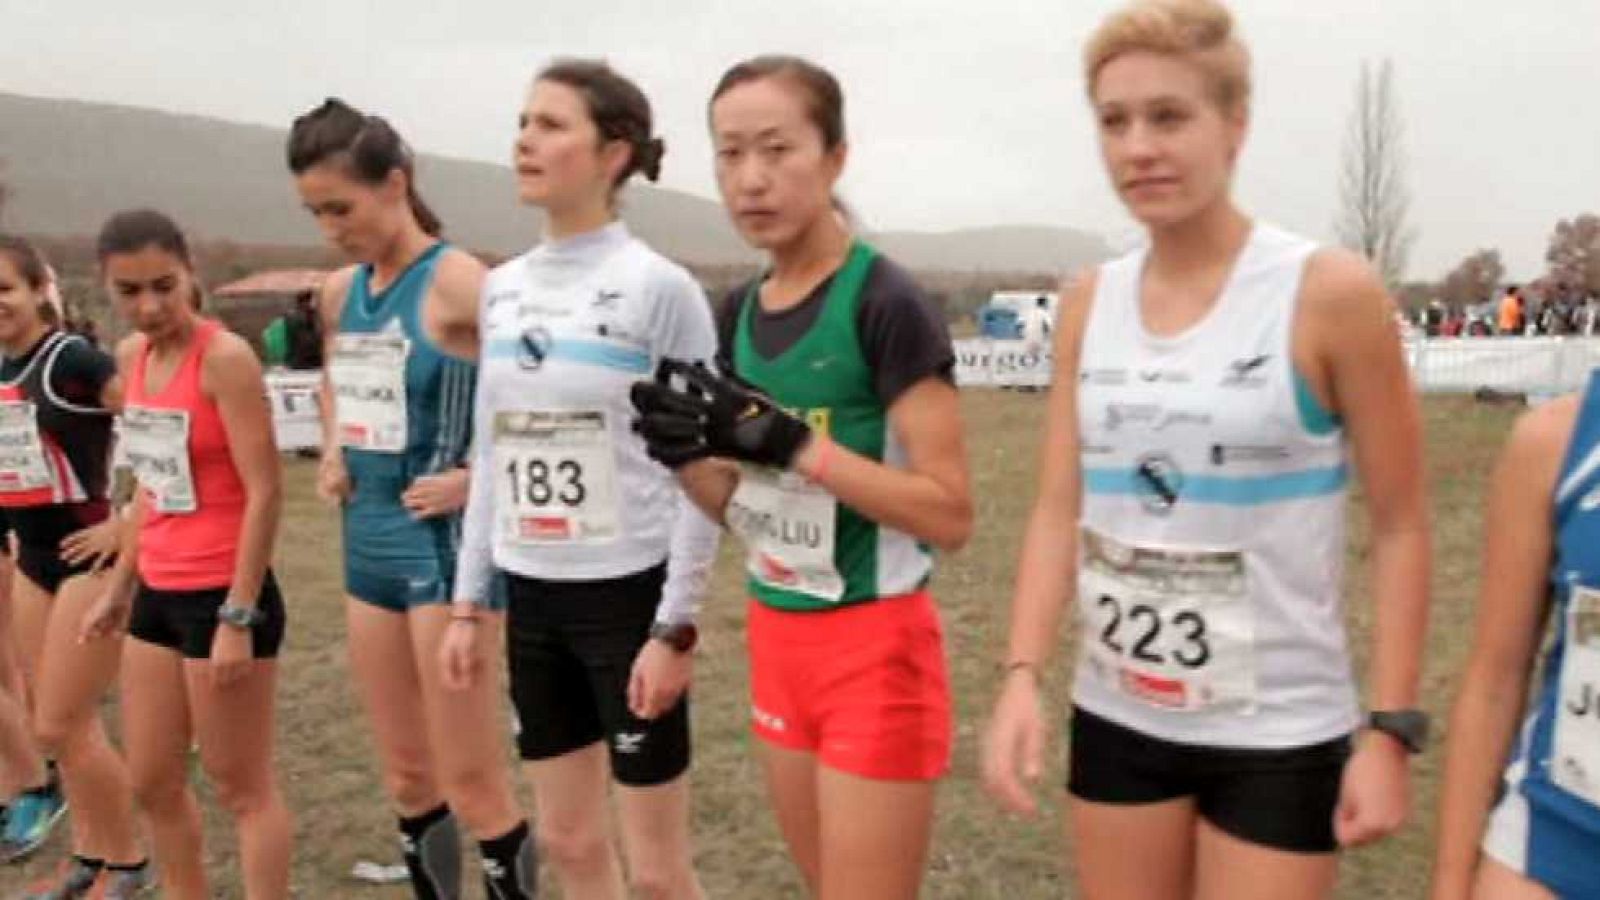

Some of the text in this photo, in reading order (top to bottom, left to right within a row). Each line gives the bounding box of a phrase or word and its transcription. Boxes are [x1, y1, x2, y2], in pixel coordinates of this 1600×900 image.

[507, 459, 586, 507] 183
[781, 518, 821, 549] LIU
[1098, 593, 1211, 668] 223
[1566, 683, 1600, 717] J
